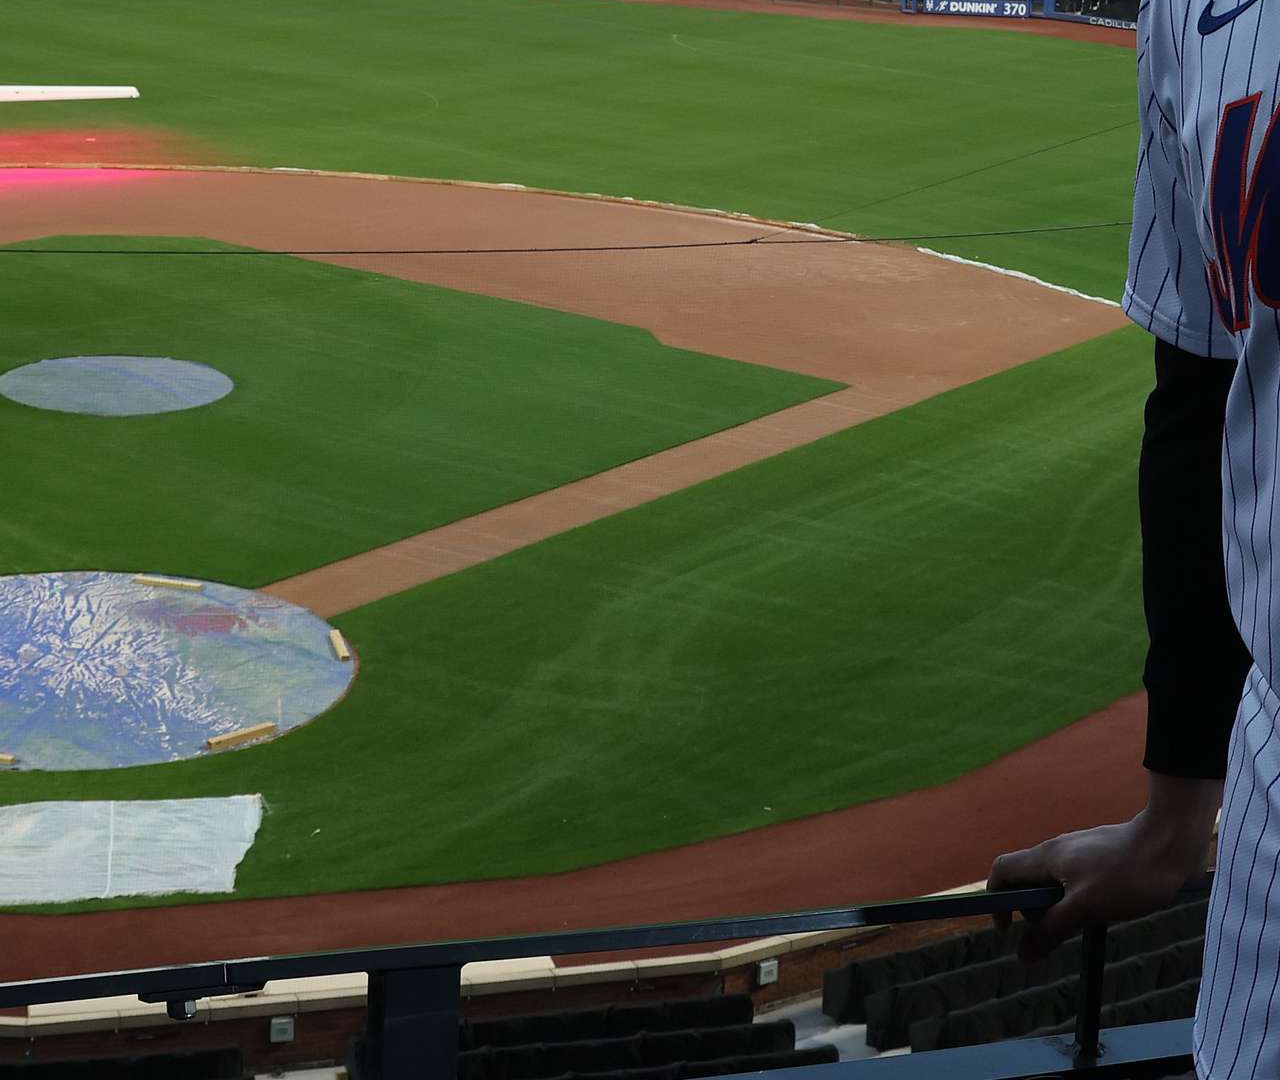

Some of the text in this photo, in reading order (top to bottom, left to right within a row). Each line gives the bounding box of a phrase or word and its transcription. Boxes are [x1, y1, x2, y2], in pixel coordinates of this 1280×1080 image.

[949, 0, 998, 15] DUNKIN'
[1003, 2, 1027, 16] 370
[1089, 15, 1137, 31] CADILLA
